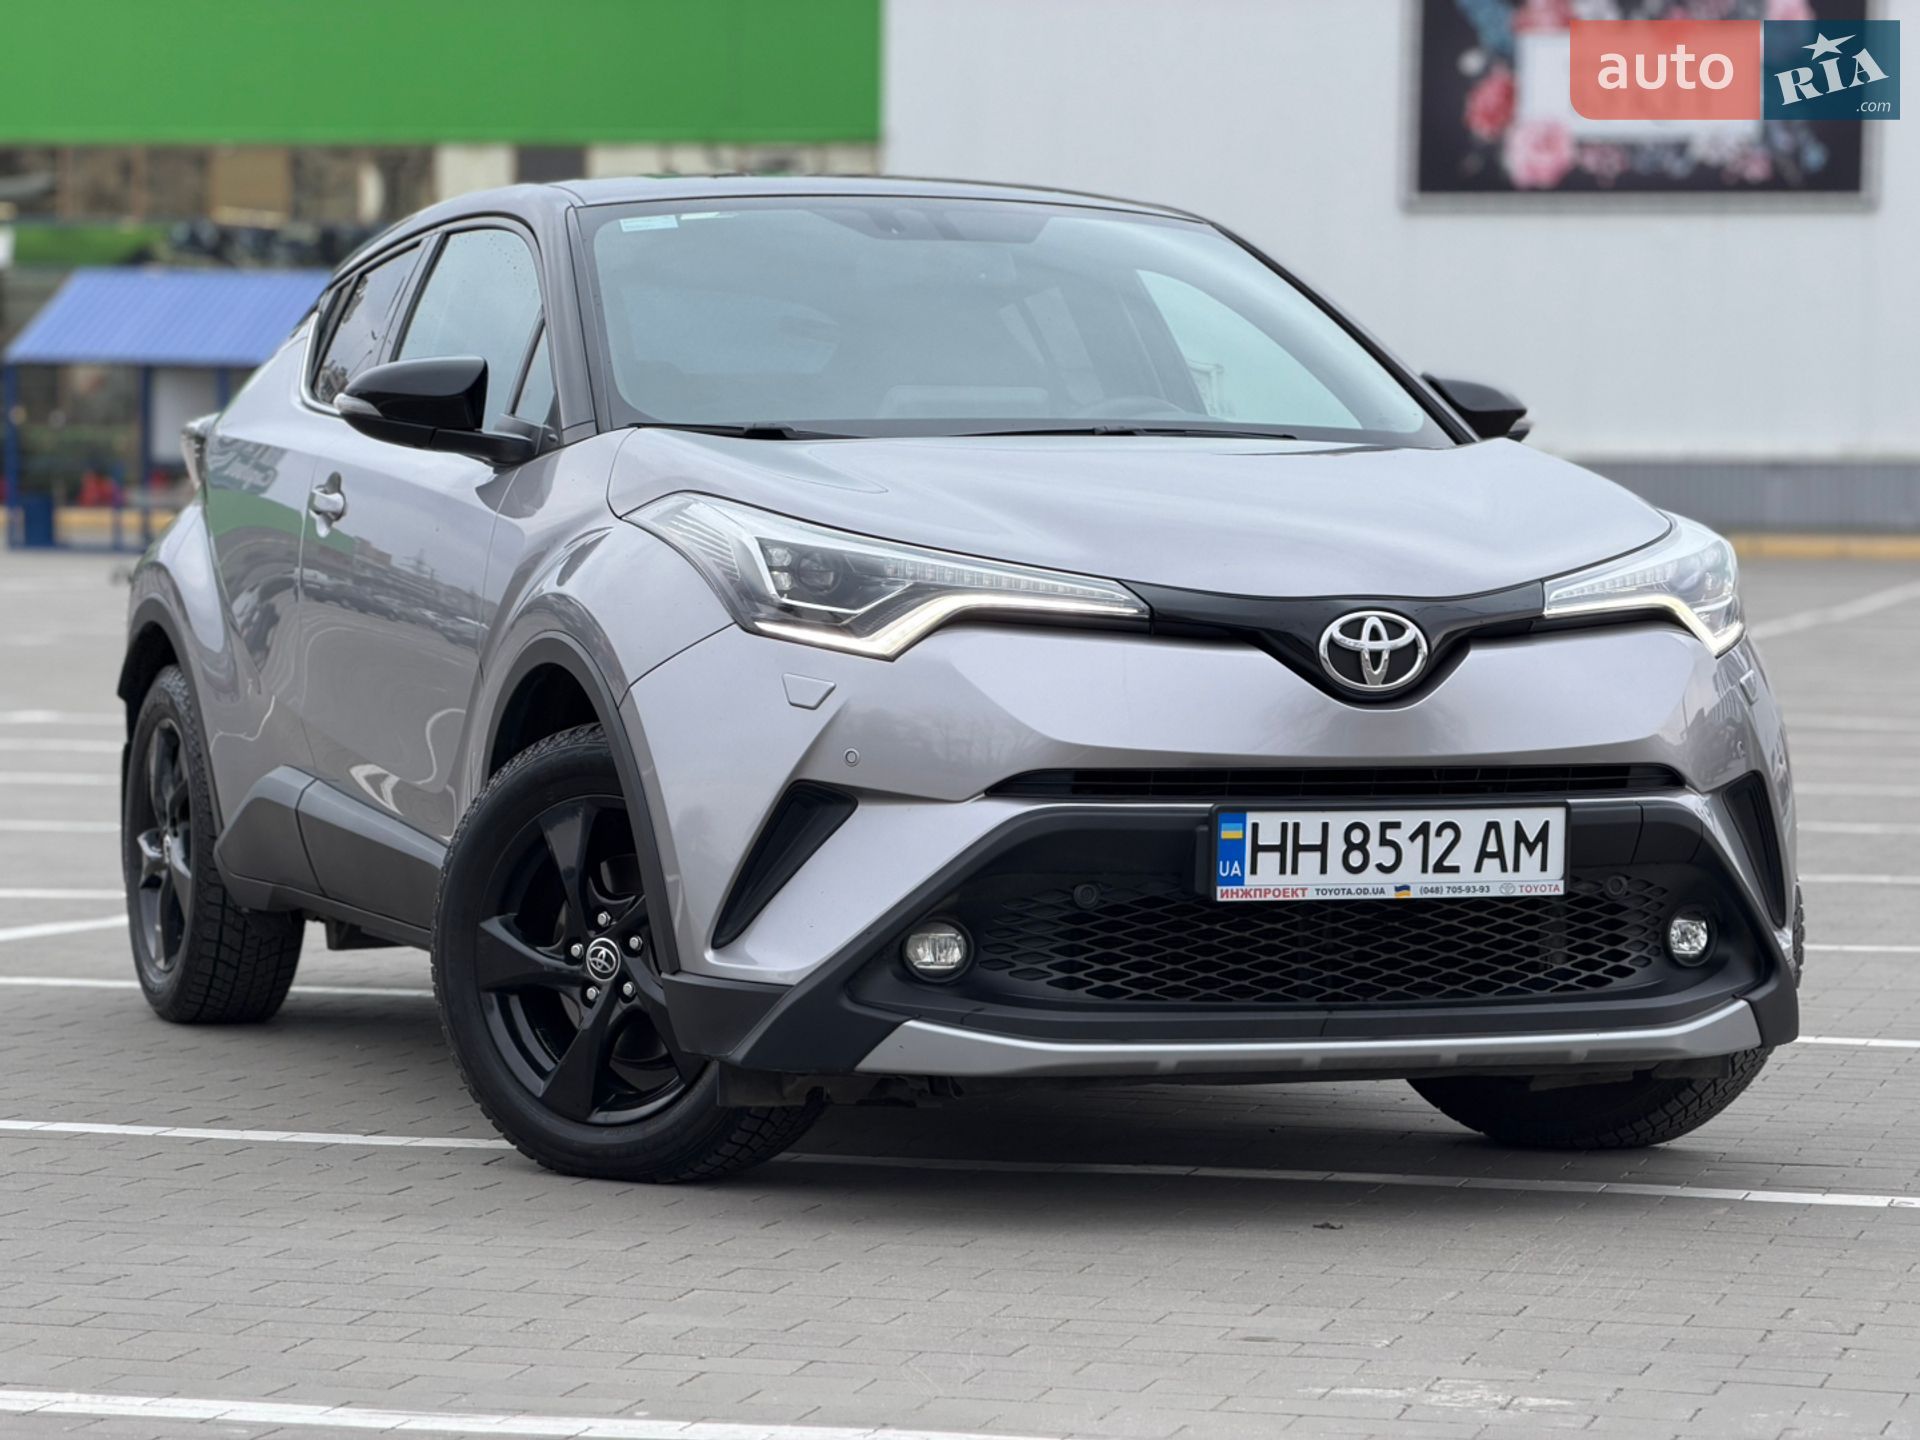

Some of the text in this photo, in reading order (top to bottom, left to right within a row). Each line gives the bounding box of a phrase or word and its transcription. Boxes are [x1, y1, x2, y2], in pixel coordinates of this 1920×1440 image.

[1250, 819, 1550, 875] HH 8512 AM
[1219, 861, 1242, 877] UA
[1220, 887, 1308, 899] ИНЖПРОЕКТ
[1315, 887, 1386, 896] TOYOTA.OD.UA
[1419, 885, 1490, 895] (048) 705-93-93
[1519, 883, 1560, 893] TOYOTA
